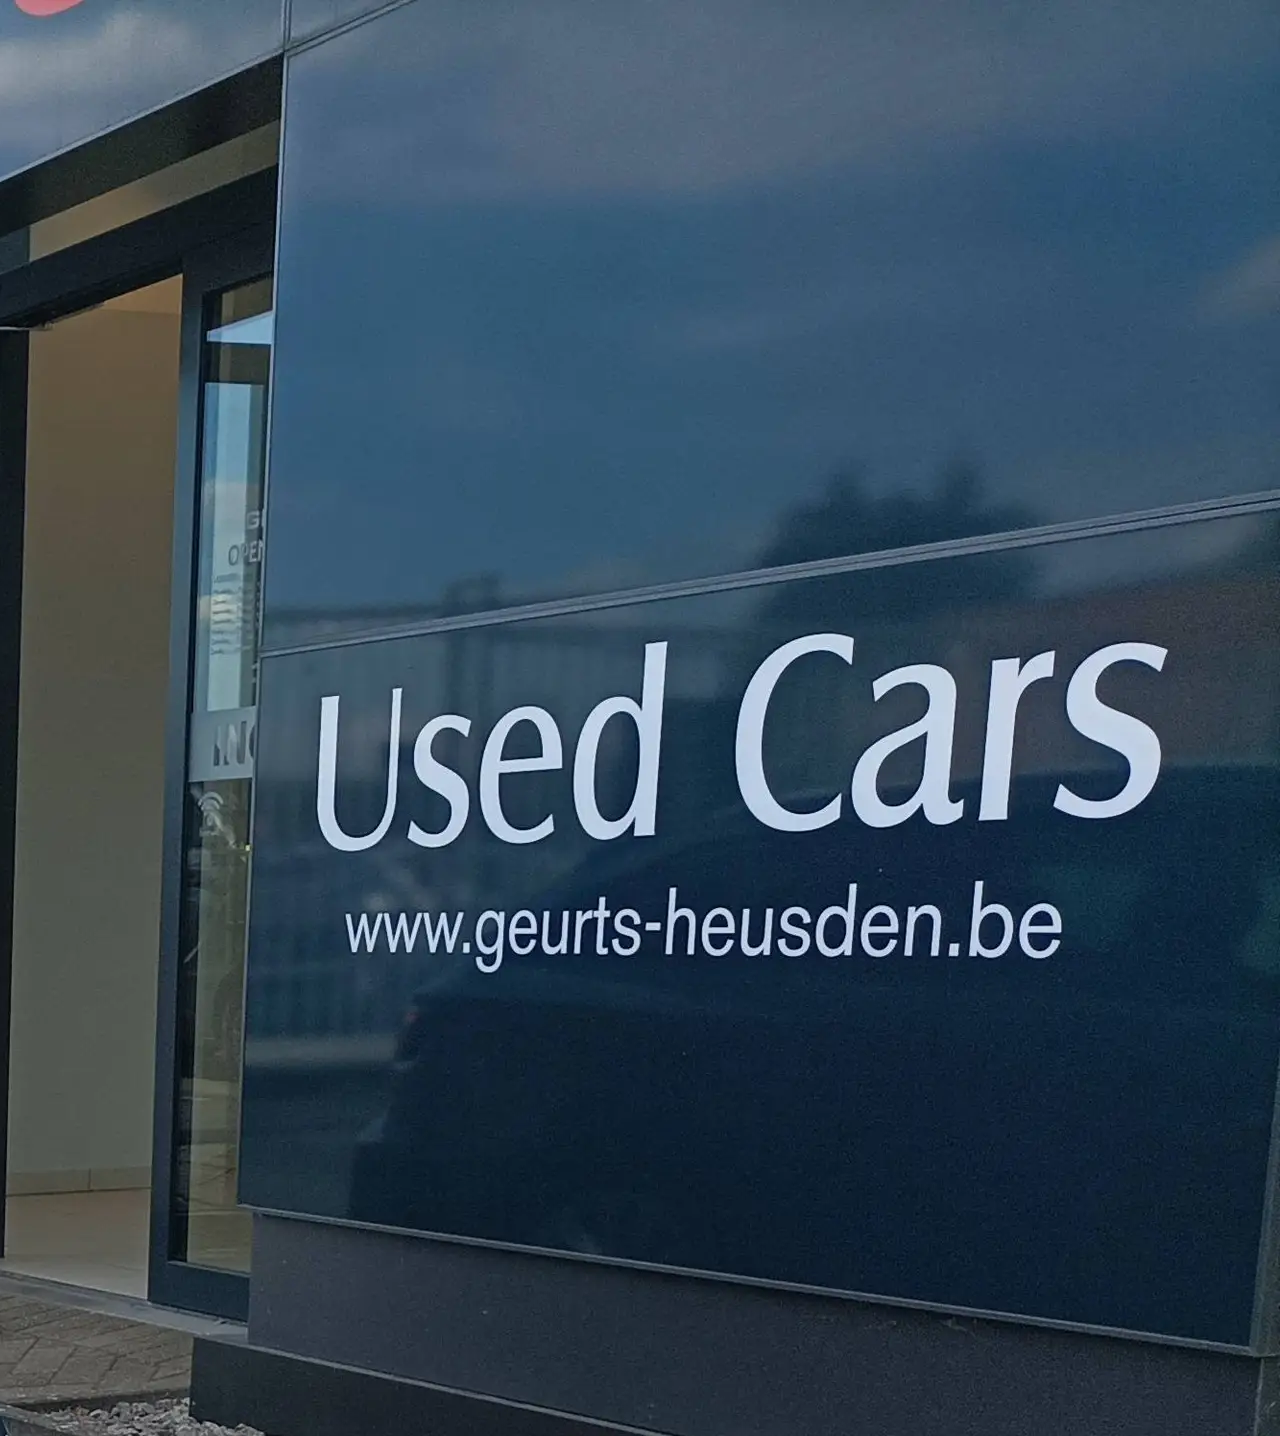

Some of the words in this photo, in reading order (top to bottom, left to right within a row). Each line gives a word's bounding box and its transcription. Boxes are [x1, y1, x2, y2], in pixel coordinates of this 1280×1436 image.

[317, 642, 668, 852] Used
[735, 633, 1168, 832] Cars
[345, 880, 1062, 973] www.geurts-heusden.be
